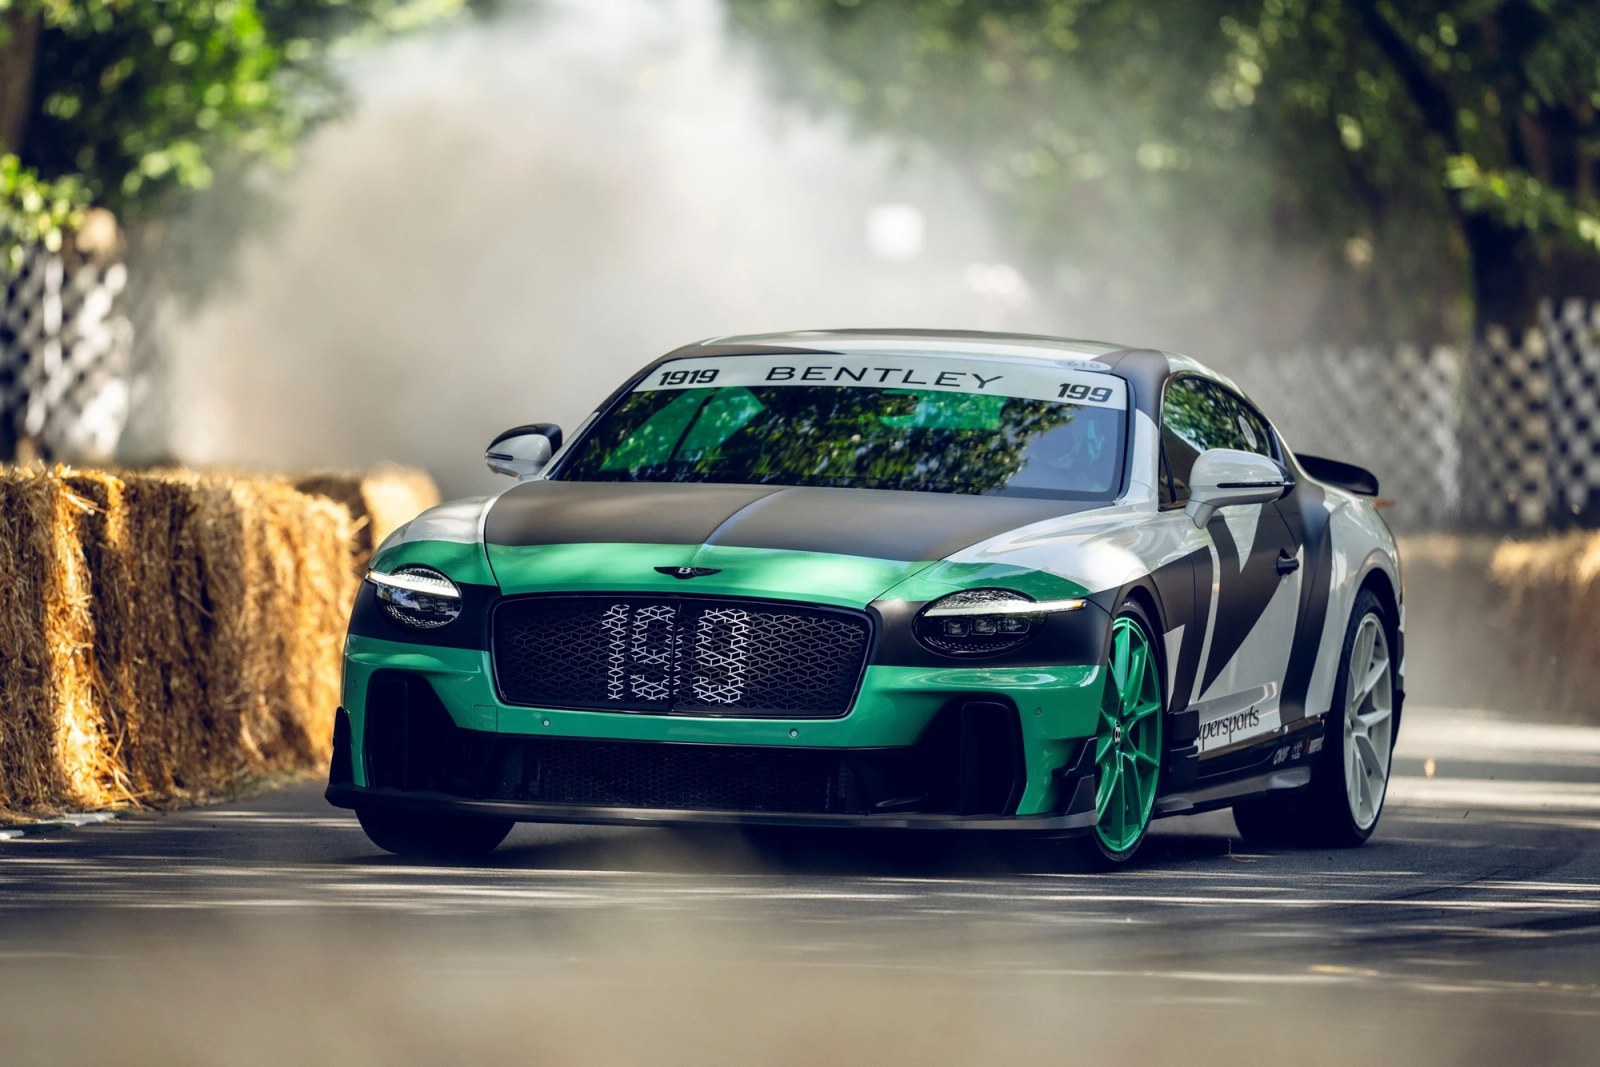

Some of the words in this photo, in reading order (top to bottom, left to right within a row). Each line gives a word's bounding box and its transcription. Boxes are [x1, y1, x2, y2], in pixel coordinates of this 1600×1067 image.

[658, 368, 720, 386] 1919
[765, 366, 1004, 389] BENTLEY
[1057, 382, 1113, 403] 199
[601, 604, 749, 703] 199
